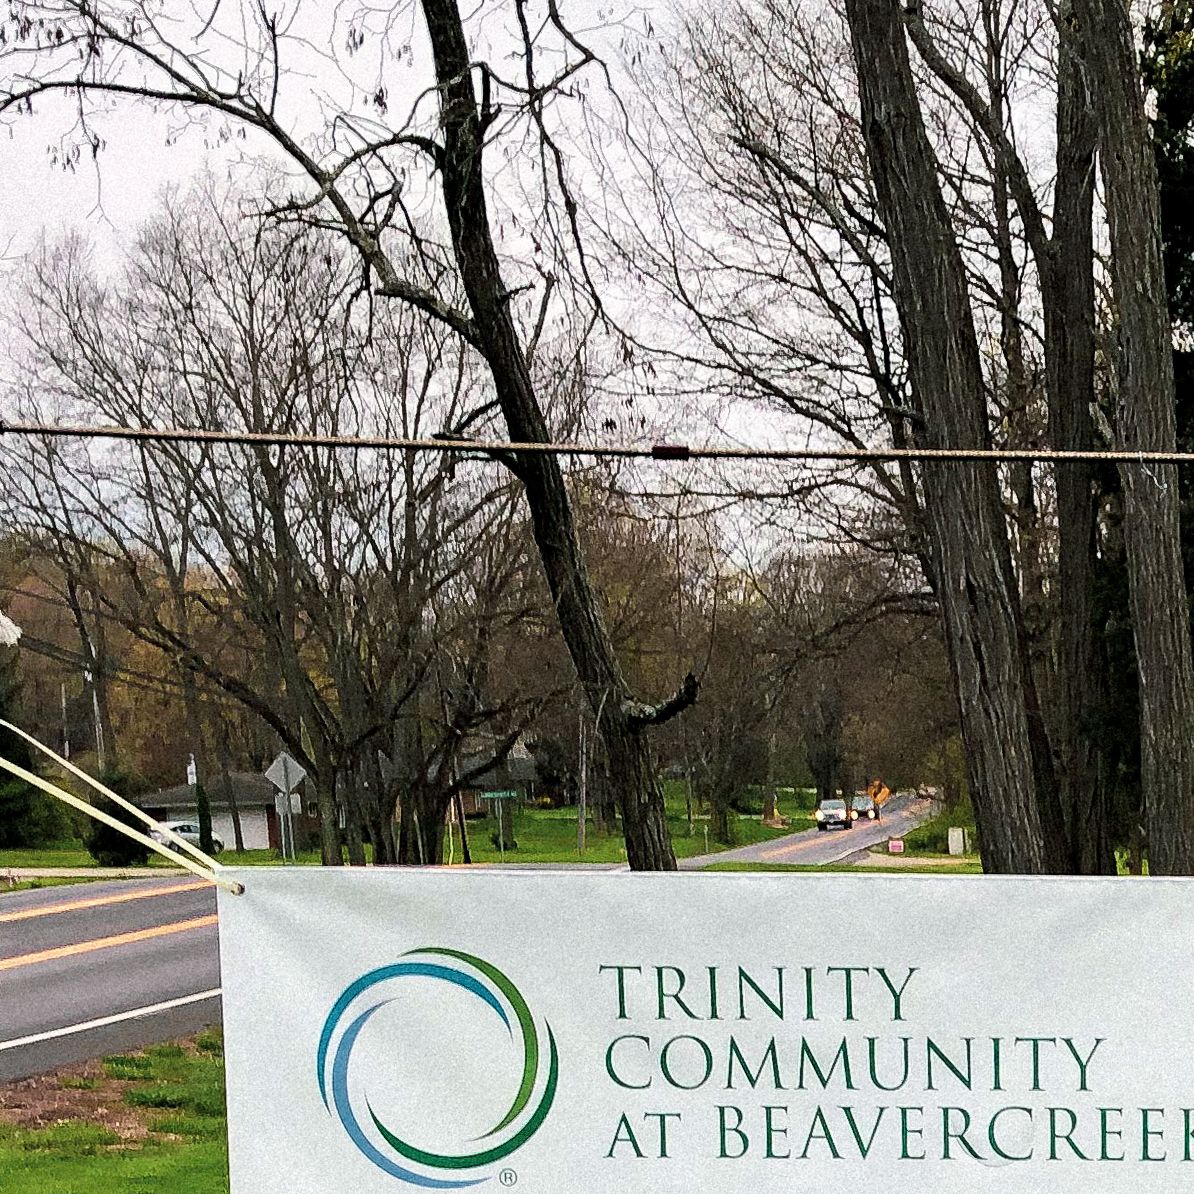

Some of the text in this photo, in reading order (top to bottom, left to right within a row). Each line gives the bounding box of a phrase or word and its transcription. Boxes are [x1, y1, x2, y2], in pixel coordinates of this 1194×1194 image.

[599, 965, 919, 1021] TRINITY
[605, 1035, 1105, 1091] COMMUNITY
[604, 1110, 682, 1159] AT
